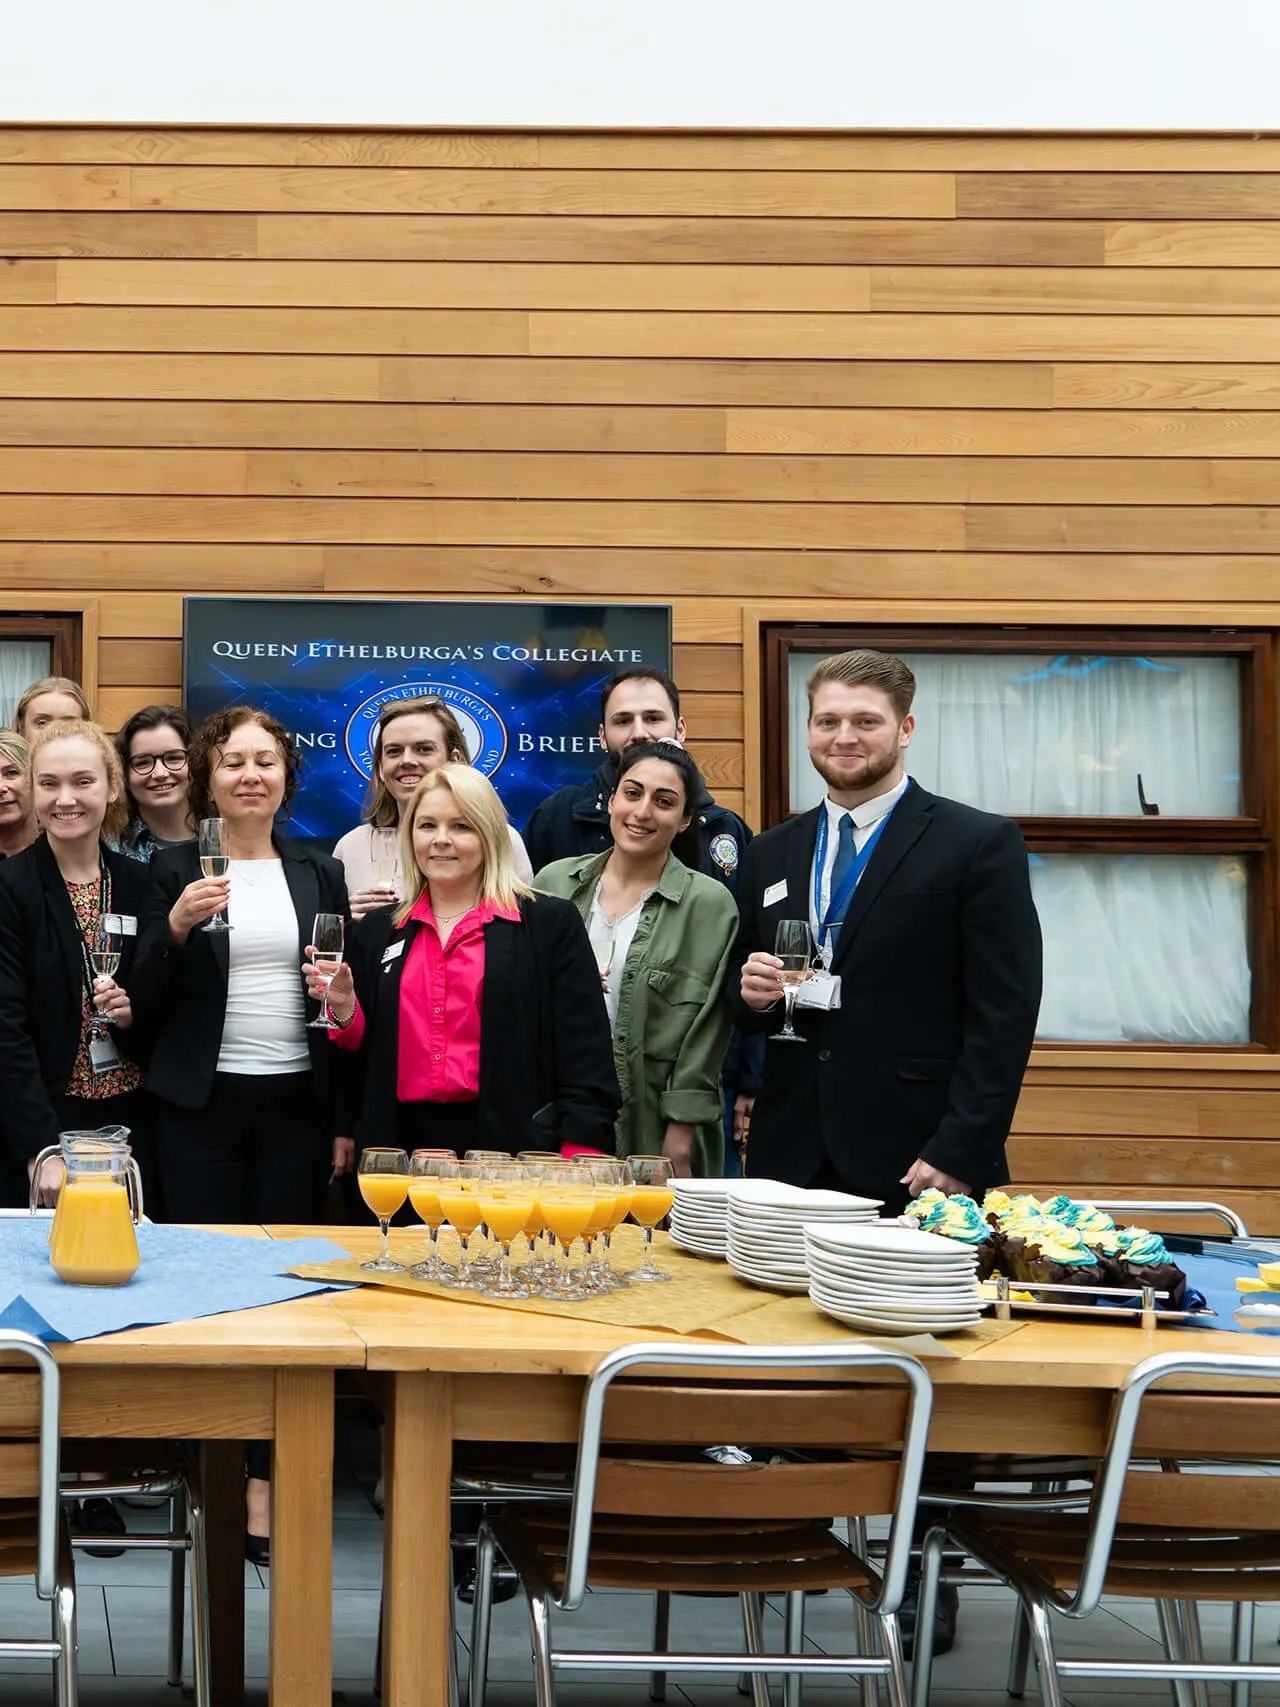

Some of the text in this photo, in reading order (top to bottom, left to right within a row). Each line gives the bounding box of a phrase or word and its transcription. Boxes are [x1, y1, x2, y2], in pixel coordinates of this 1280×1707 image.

[212, 640, 643, 663] QUEEN ETHELBURGA'S COLLEGIATE
[518, 733, 609, 753] BRIEF
